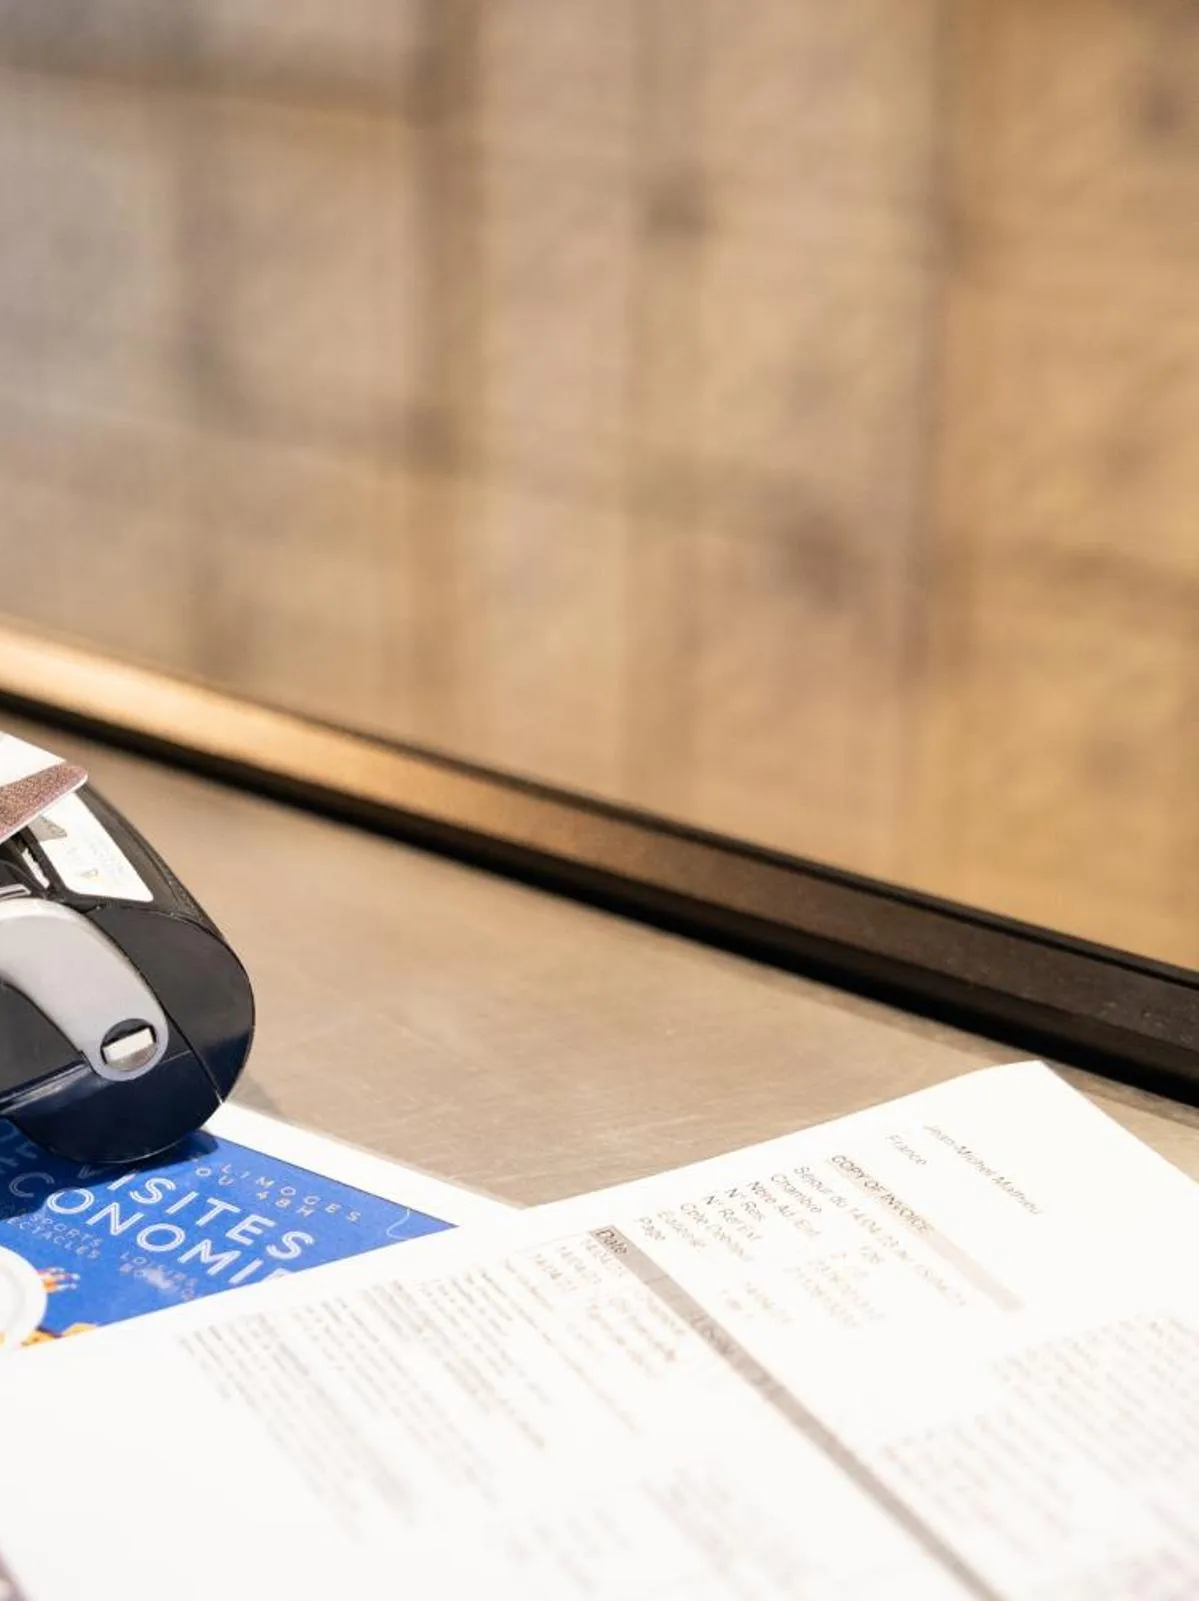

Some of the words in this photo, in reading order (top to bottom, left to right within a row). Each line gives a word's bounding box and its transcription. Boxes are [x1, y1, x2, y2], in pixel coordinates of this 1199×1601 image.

[77, 1163, 314, 1260] ISITES
[221, 1163, 361, 1222] LIMOGES
[831, 1155, 868, 1180] COPY
[877, 1193, 935, 1232] INVOICE
[0, 1213, 101, 1260] ECTACLES
[595, 1229, 627, 1255] Date
